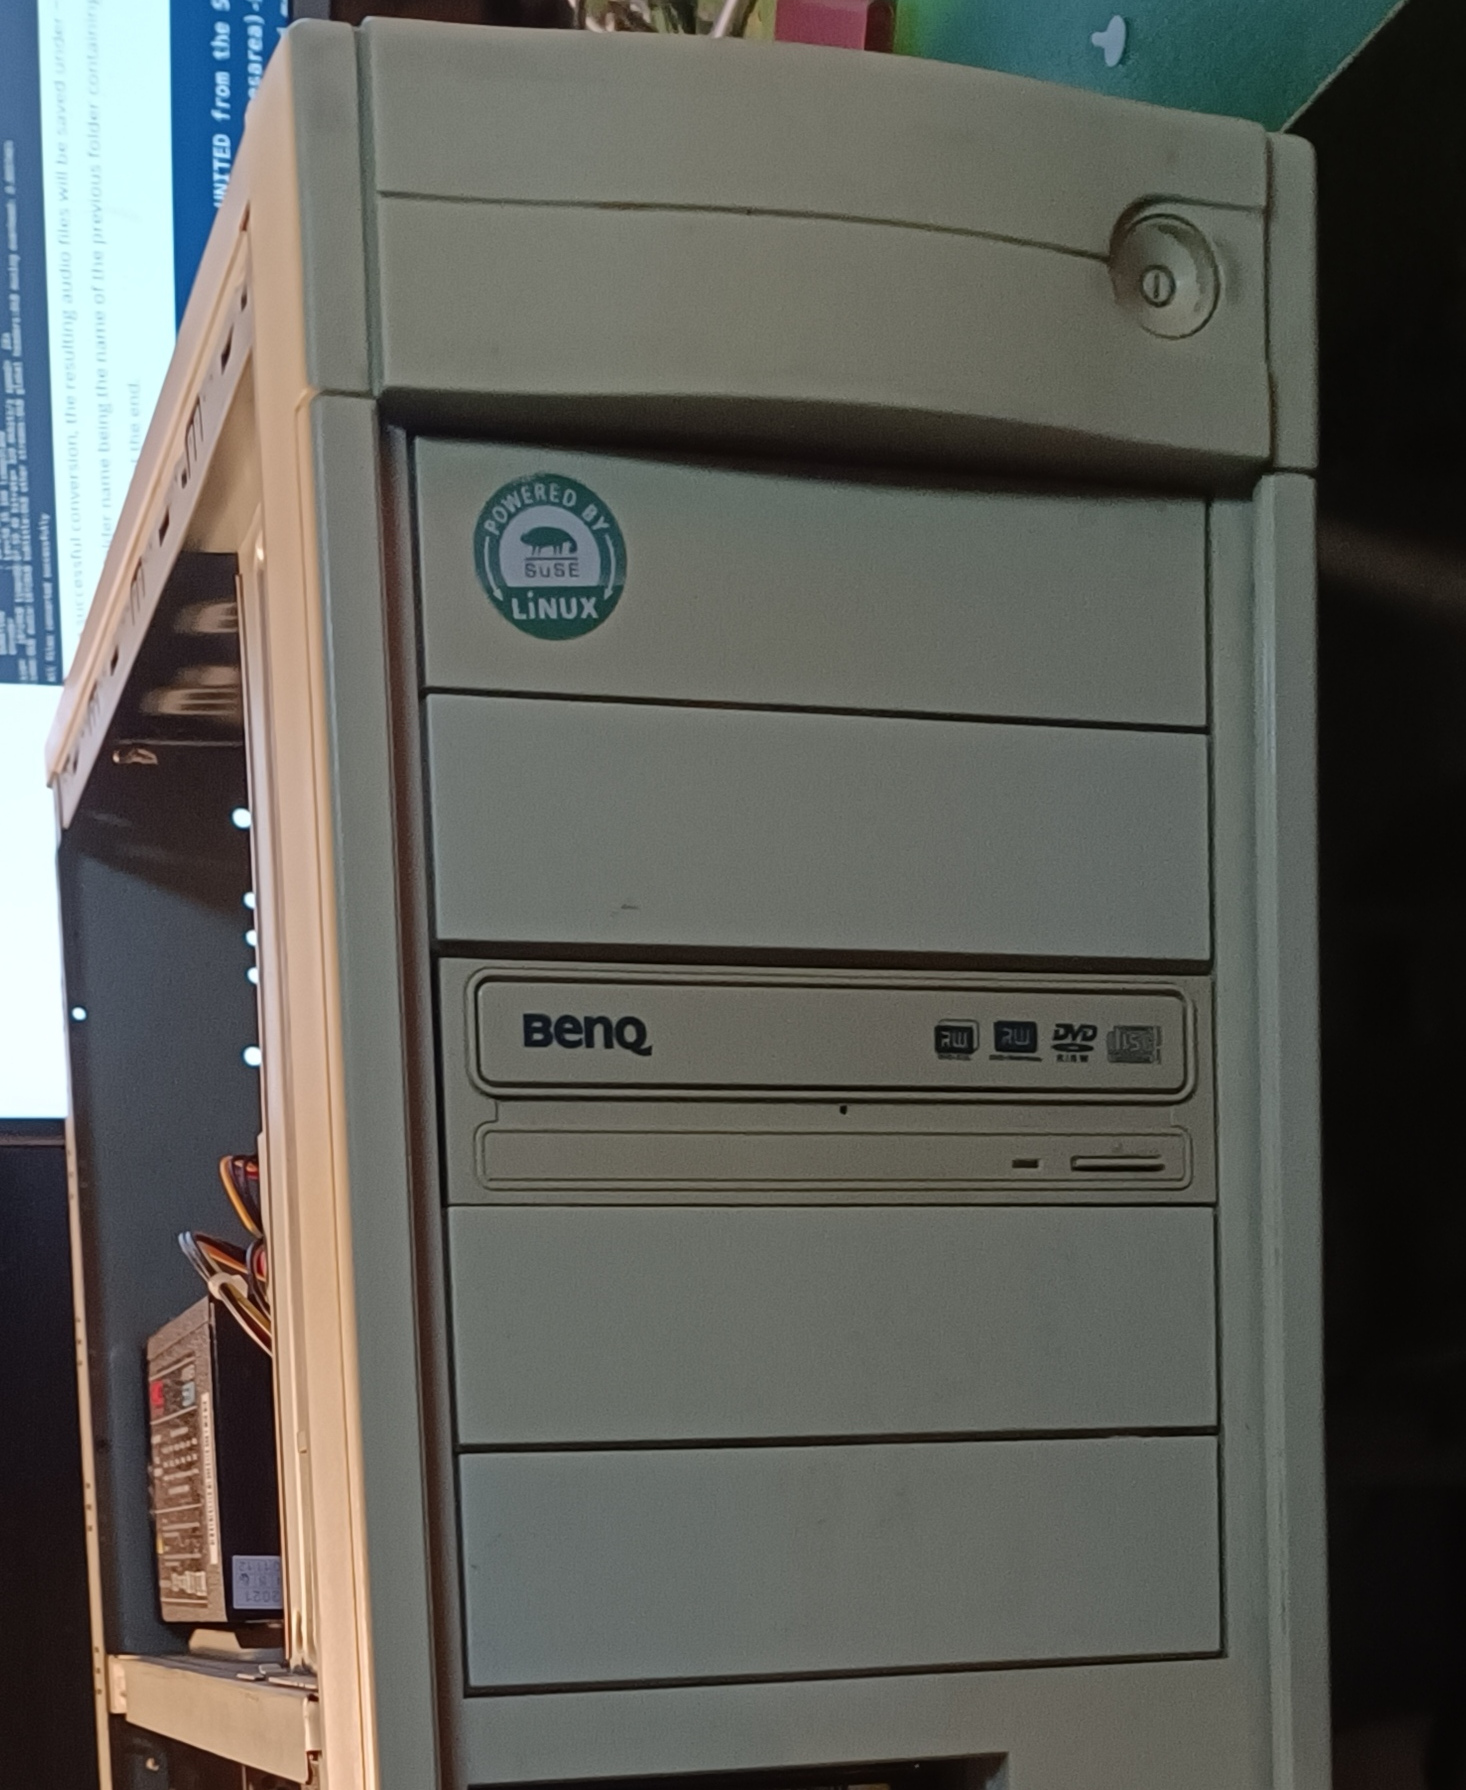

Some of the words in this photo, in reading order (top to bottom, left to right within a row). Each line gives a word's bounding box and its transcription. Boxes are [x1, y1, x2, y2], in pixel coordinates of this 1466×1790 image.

[52, 18, 66, 75] under
[209, 21, 231, 61] the
[53, 80, 68, 136] saved
[210, 71, 231, 121] from
[54, 141, 69, 166] be
[86, 103, 102, 158] folder
[55, 171, 70, 202] will
[89, 164, 108, 245] previous
[57, 208, 71, 245] files
[58, 251, 73, 304] audio
[90, 250, 105, 281] the
[91, 285, 105, 305] of
[59, 310, 78, 390] resulting
[92, 310, 107, 362] name
[94, 368, 109, 397] the
[63, 395, 77, 424] the
[95, 403, 112, 452] being
[127, 424, 141, 451] the
[65, 430, 82, 532] conversion,
[97, 456, 112, 508] name
[484, 482, 577, 536] POWERED
[583, 504, 610, 532] BY
[1052, 1023, 1098, 1042] DVD
